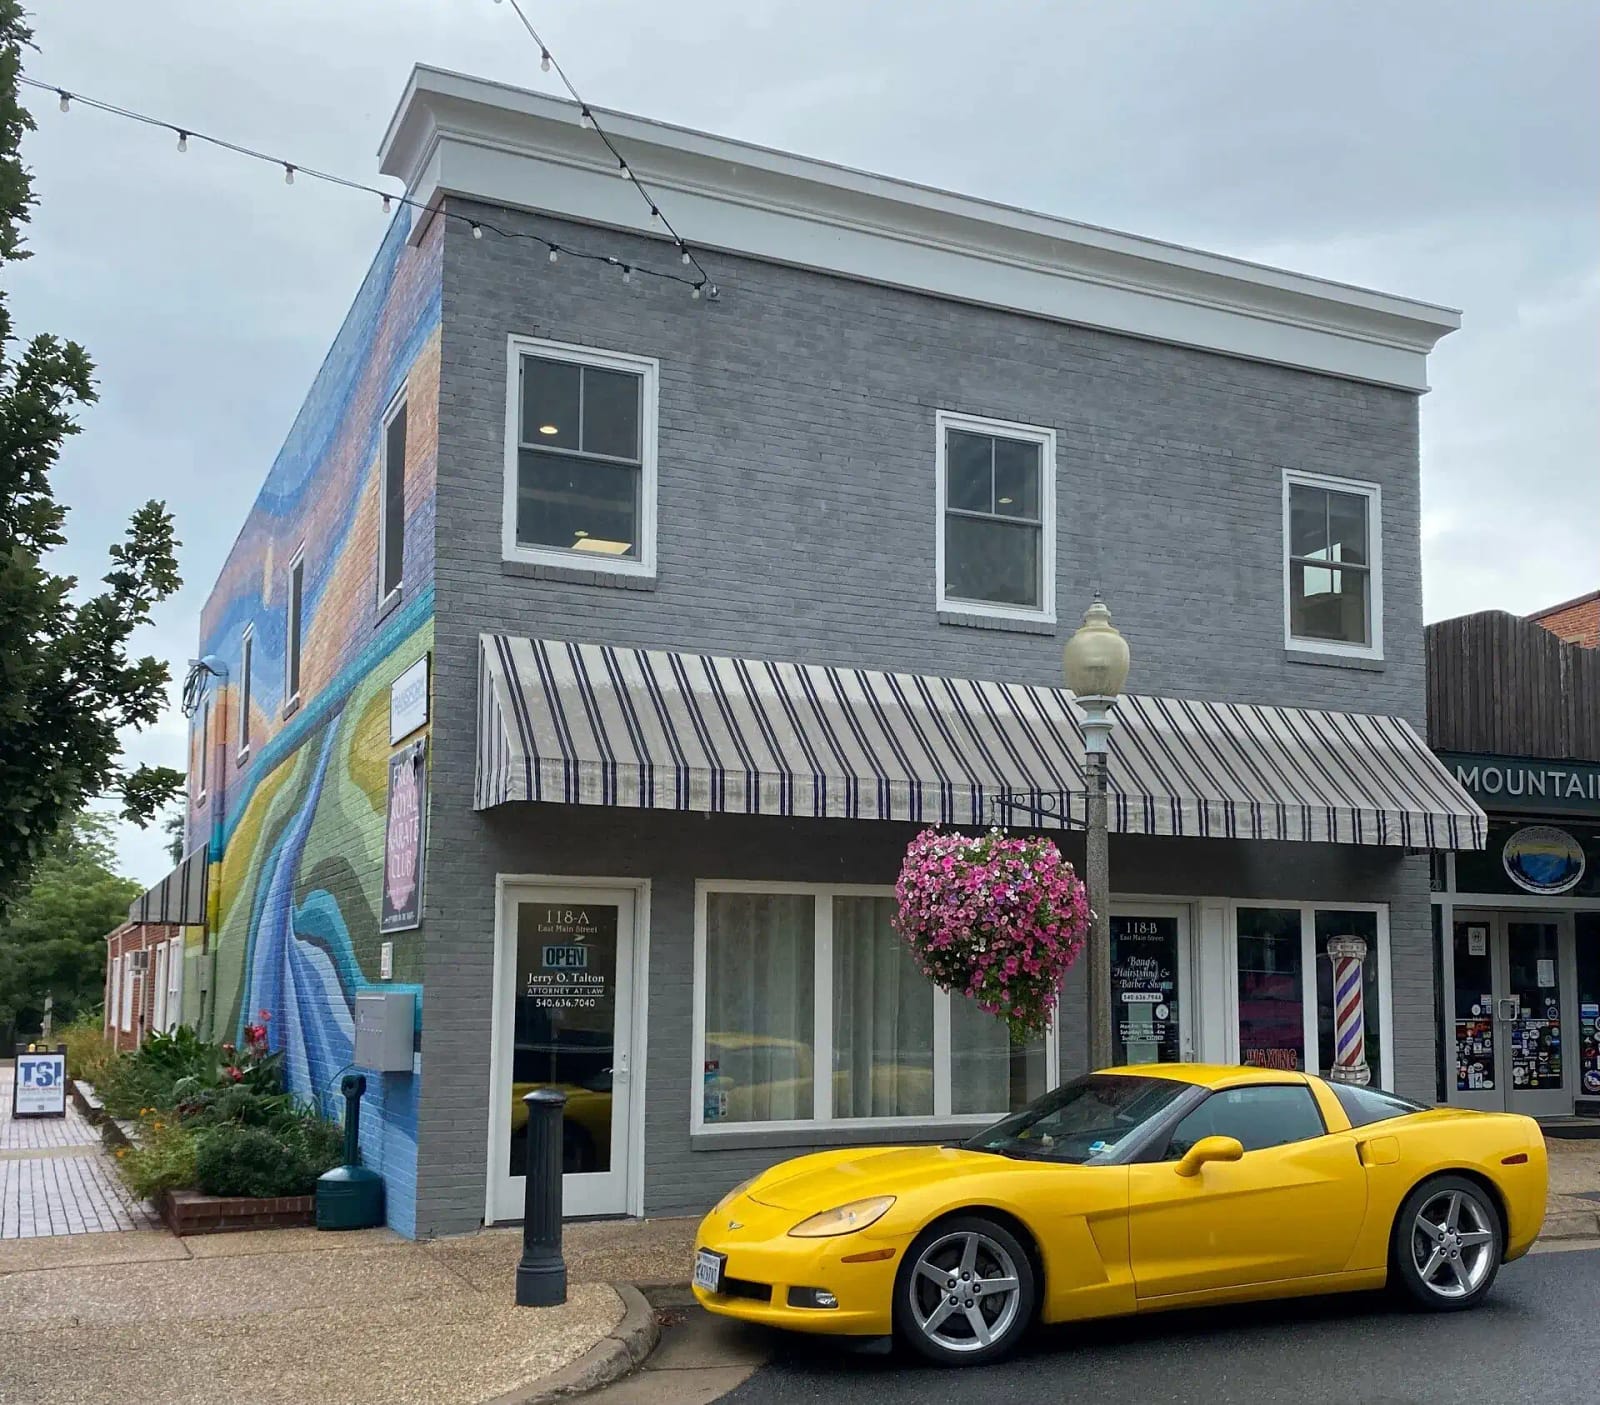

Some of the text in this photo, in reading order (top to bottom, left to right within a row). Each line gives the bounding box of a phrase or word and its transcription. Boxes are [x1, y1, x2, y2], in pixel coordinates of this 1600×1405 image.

[1456, 765, 1600, 799] MOUNTAI
[391, 788, 418, 822] ROYAL
[388, 816, 420, 850] KARATE
[391, 849, 412, 879] CLUB
[546, 910, 590, 924] 118-A
[537, 924, 598, 934] East Main Street
[1127, 921, 1158, 934] 118-B
[545, 947, 585, 966] OPEN
[527, 972, 605, 985] Jerry O. Talton
[1119, 978, 1146, 989] Barber
[528, 987, 604, 995] ATTORNEY AT LAW
[536, 998, 595, 1008] 540.636.7040
[1246, 1048, 1297, 1070] WAXING
